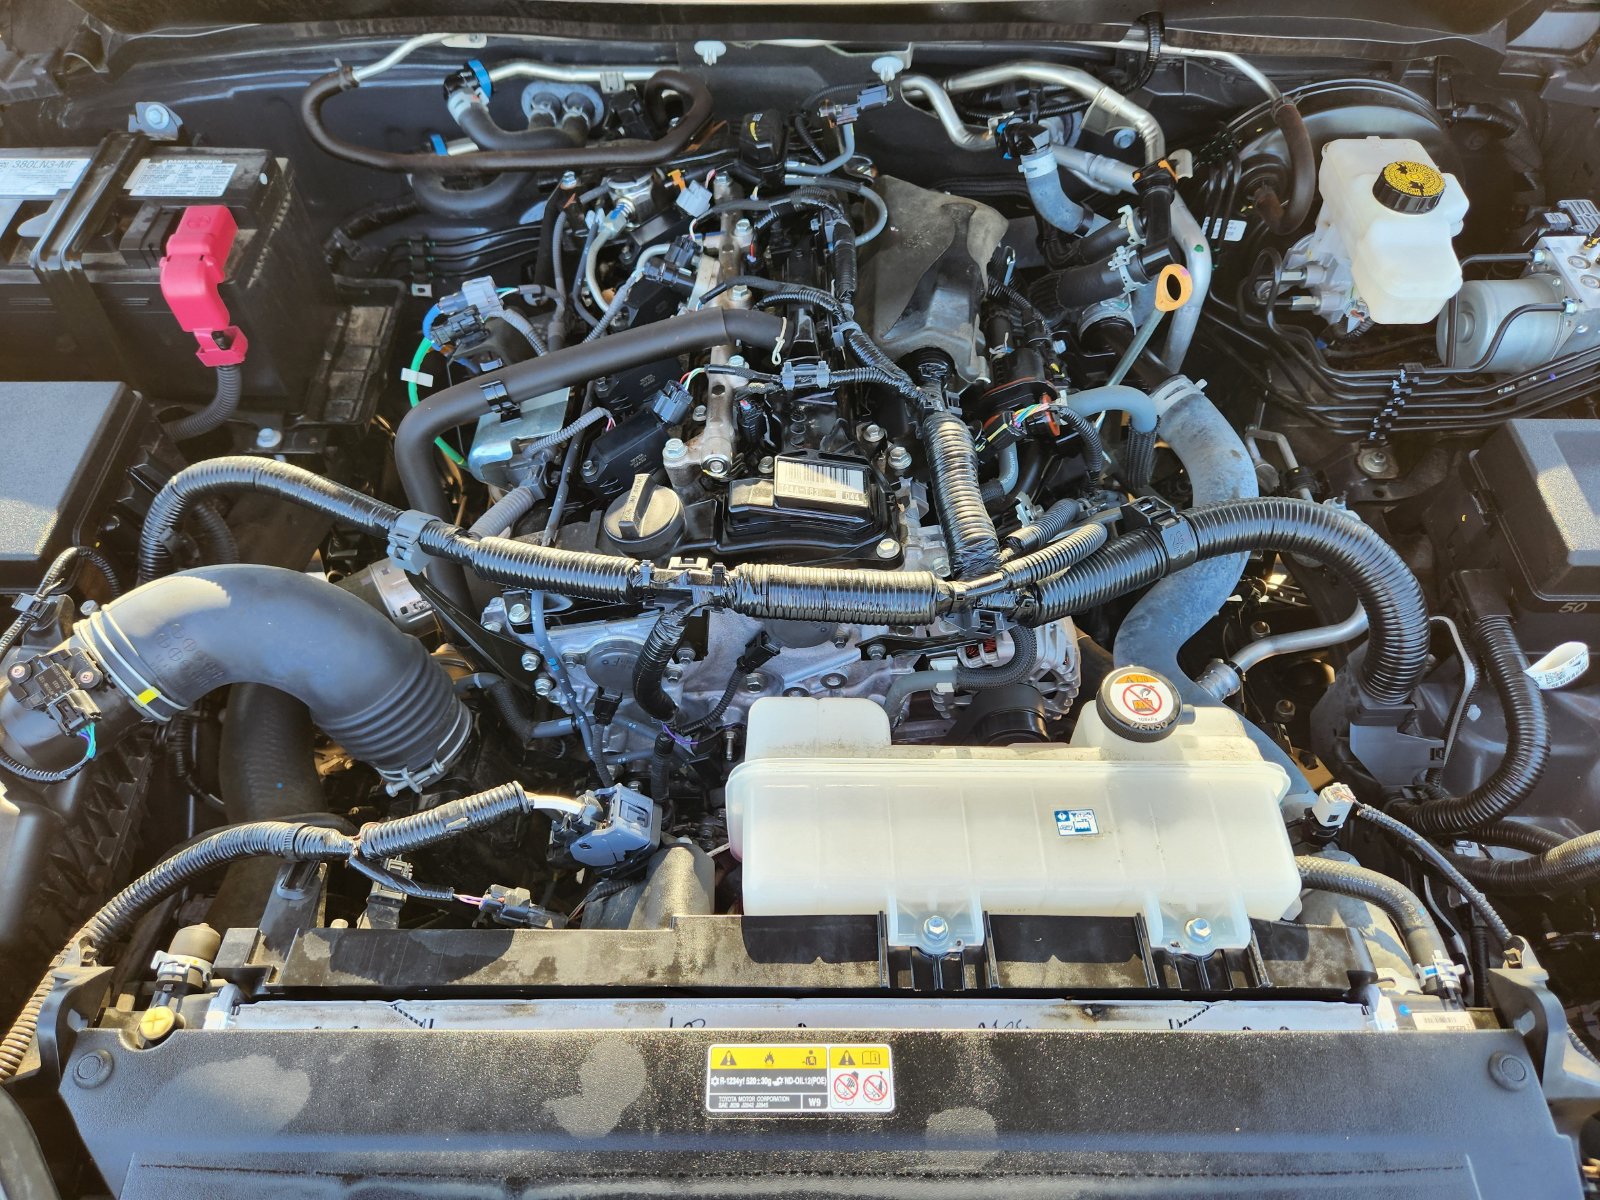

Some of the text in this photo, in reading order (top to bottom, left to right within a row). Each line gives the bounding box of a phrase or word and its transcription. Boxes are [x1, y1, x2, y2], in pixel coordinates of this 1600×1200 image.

[1558, 602, 1588, 613] 50
[1131, 720, 1168, 730] DENSO
[808, 1097, 821, 1107] W9
